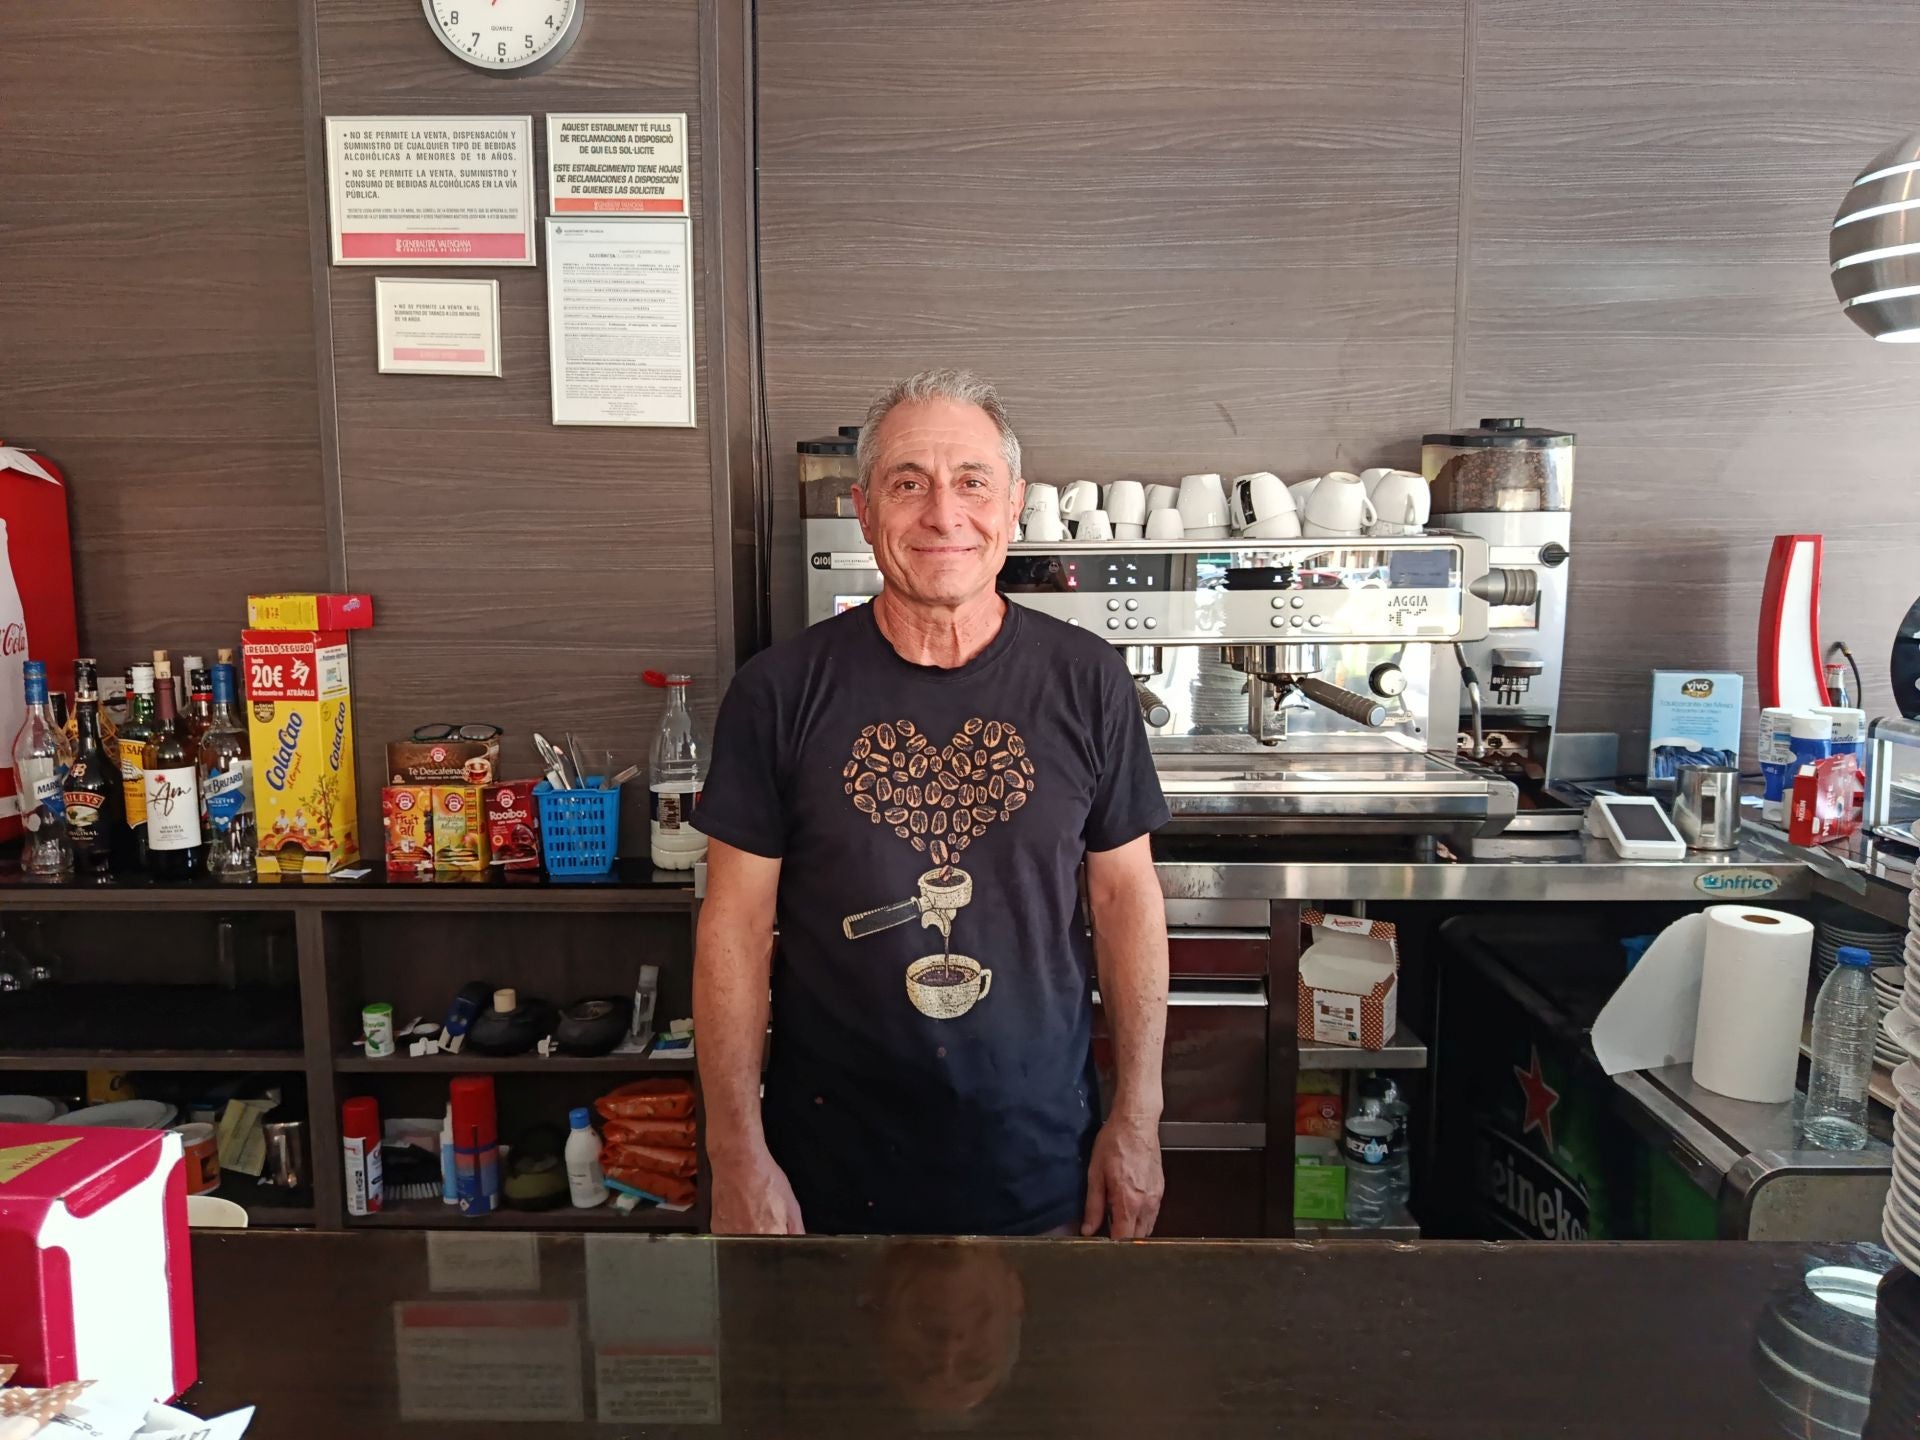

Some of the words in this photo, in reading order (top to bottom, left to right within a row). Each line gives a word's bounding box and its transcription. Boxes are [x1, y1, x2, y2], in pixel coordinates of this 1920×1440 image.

[451, 11, 459, 24] 8
[544, 15, 554, 28] 4
[472, 32, 480, 47] 7
[525, 35, 533, 48] 5
[498, 42, 506, 56] 6
[640, 122, 648, 132] TÉ
[424, 132, 450, 140] VENTA,
[453, 130, 508, 139] DISPENSACIÓN
[560, 135, 569, 143] DE
[572, 135, 626, 143] RECLAMACIONS
[628, 135, 633, 143] A
[635, 134, 673, 143] DISPOSICIÓ
[344, 151, 400, 161] ALCOHÓLICAS
[491, 152, 516, 161] AÑOS.
[554, 164, 570, 172] ESTE
[572, 164, 635, 172] ESTABLECIMIENTO
[430, 170, 456, 178] VENTA,
[556, 175, 566, 183] DE
[568, 175, 626, 183] RECLAMACIONES
[628, 175, 633, 183] A
[635, 175, 679, 184] DISPOSICIÓN
[430, 179, 480, 188] ALCOHÓLICAS
[505, 179, 517, 188] VÍA
[346, 190, 379, 199] PÚBLICA.
[252, 665, 283, 688] 20€
[330, 701, 345, 771] ColaCao
[266, 712, 302, 791] ColaCao
[396, 813, 419, 825] Fruit
[400, 826, 414, 836] all
[1721, 875, 1773, 889] infrico
